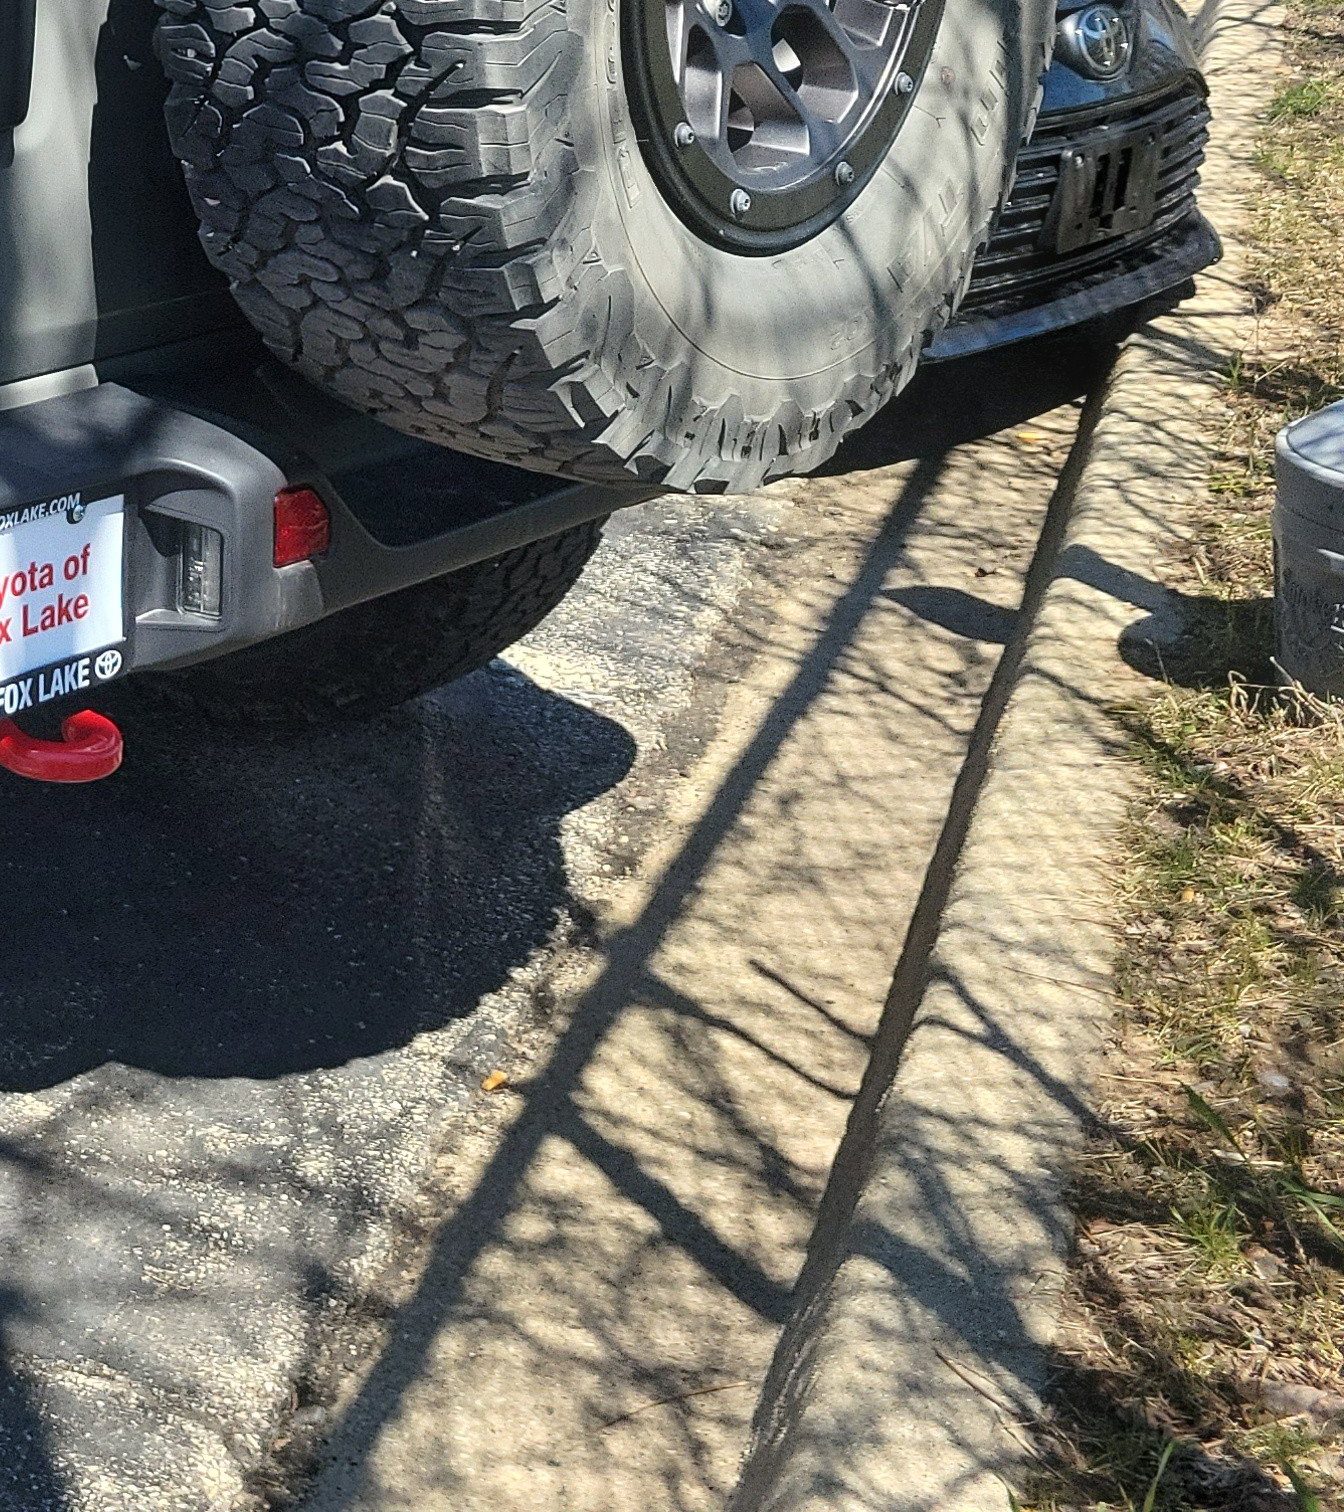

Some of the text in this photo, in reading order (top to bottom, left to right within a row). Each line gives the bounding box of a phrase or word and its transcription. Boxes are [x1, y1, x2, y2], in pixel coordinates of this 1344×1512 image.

[63, 542, 91, 582] of
[21, 591, 90, 638] Lake
[37, 656, 90, 702] LAKE
